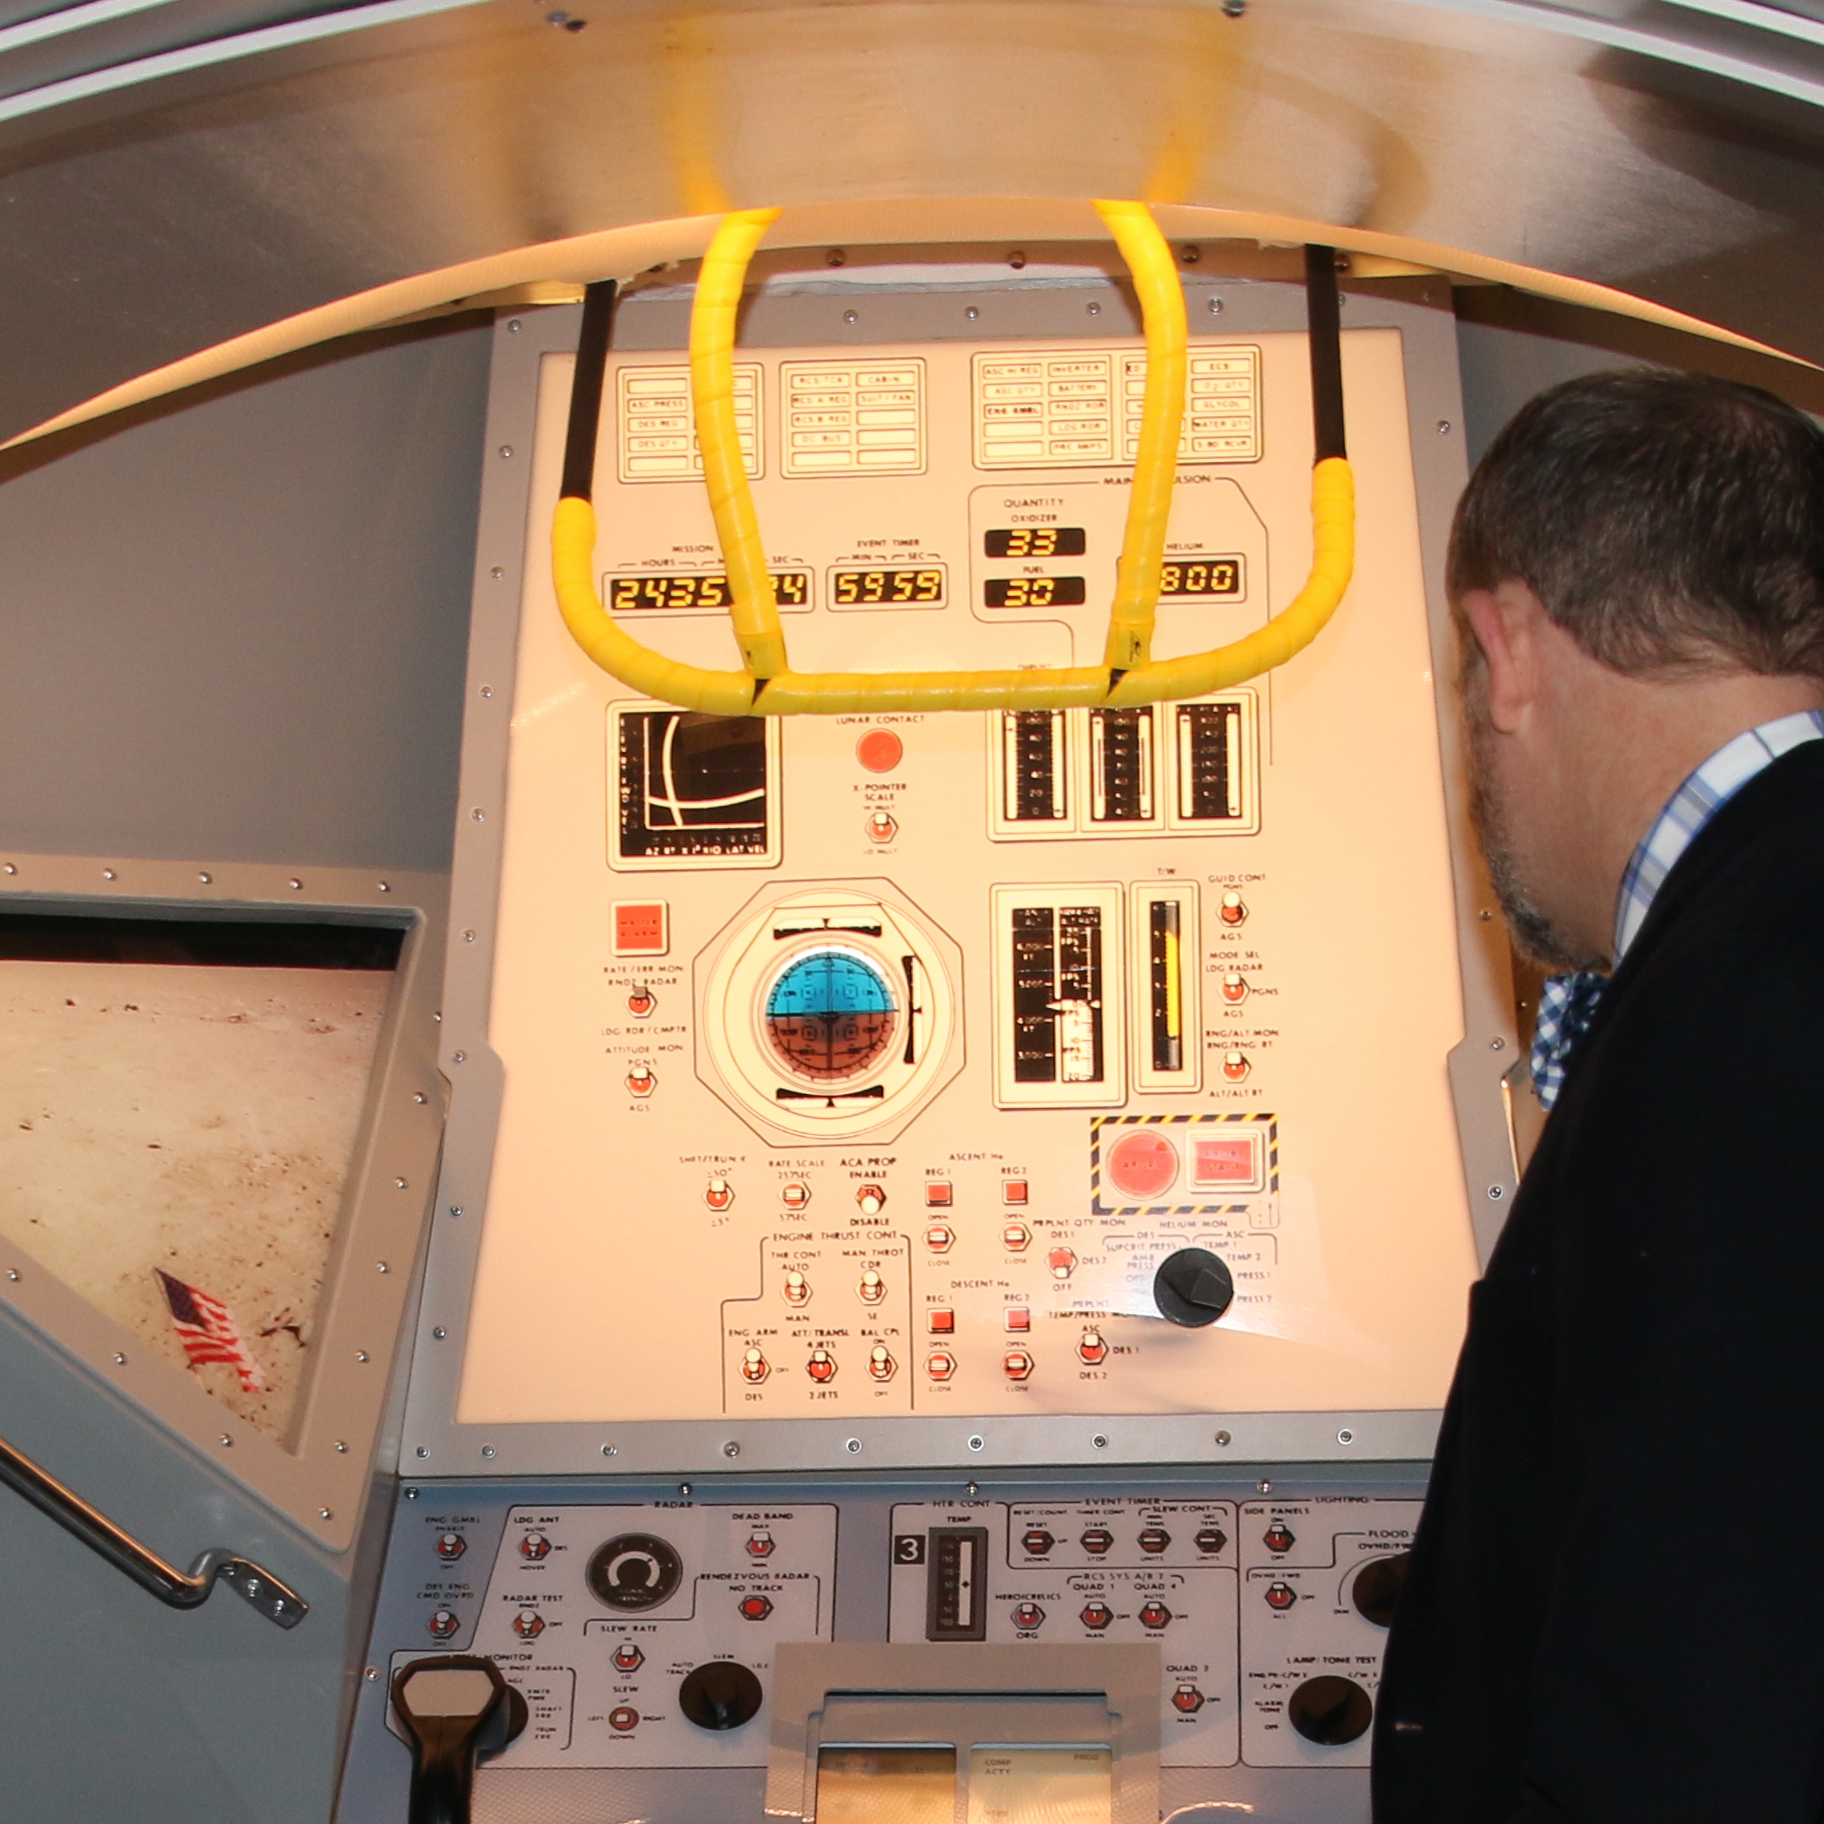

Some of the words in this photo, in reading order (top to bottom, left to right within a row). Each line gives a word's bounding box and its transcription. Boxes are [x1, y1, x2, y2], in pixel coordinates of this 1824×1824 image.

[1004, 499, 1063, 508] QUANTITY
[1011, 514, 1057, 523] OXIDIZER
[857, 539, 886, 548] EVENT
[892, 538, 919, 546] TIMER
[1006, 529, 1057, 556] 33
[1166, 542, 1204, 550] HELIUM
[672, 544, 714, 553] MISSION
[772, 555, 789, 563] SEC
[907, 552, 925, 560] SEC
[641, 559, 675, 567] HOURS
[1022, 566, 1044, 574] FUEL
[1004, 578, 1054, 607] 30
[876, 715, 924, 723] CONTACT
[865, 793, 894, 801] SCALE
[1206, 964, 1225, 972] LDG
[1229, 963, 1263, 971] RADAR
[605, 1046, 650, 1054] ATTITUDE
[629, 1104, 650, 1112] AGS
[949, 1153, 986, 1161] ASCENT
[796, 1159, 824, 1167] SCALE
[839, 1159, 862, 1167] ACA
[868, 1157, 897, 1166] PROP
[925, 1168, 944, 1176] REG
[1001, 1167, 1019, 1175] REG
[850, 1218, 890, 1226] DISABLE
[1159, 1220, 1196, 1228] HELIUM
[773, 1233, 813, 1241] ENGINE
[821, 1231, 860, 1240] THRUST
[867, 1231, 897, 1239] CONT
[1137, 1231, 1155, 1239] DES
[1225, 1230, 1244, 1238] ASC
[794, 1250, 821, 1258] CONT
[872, 1248, 904, 1256] THROT
[781, 1263, 809, 1271] AUTO
[861, 1261, 881, 1269] CDR
[951, 1280, 993, 1288] DESCENT
[756, 1328, 778, 1336] ARM
[744, 1339, 762, 1347] ASC
[933, 1500, 954, 1508] HTR
[1127, 1497, 1161, 1505] TIMER
[1271, 1507, 1309, 1515] PANELS
[900, 1538, 919, 1560] 3
[984, 1759, 1012, 1767] COMP
